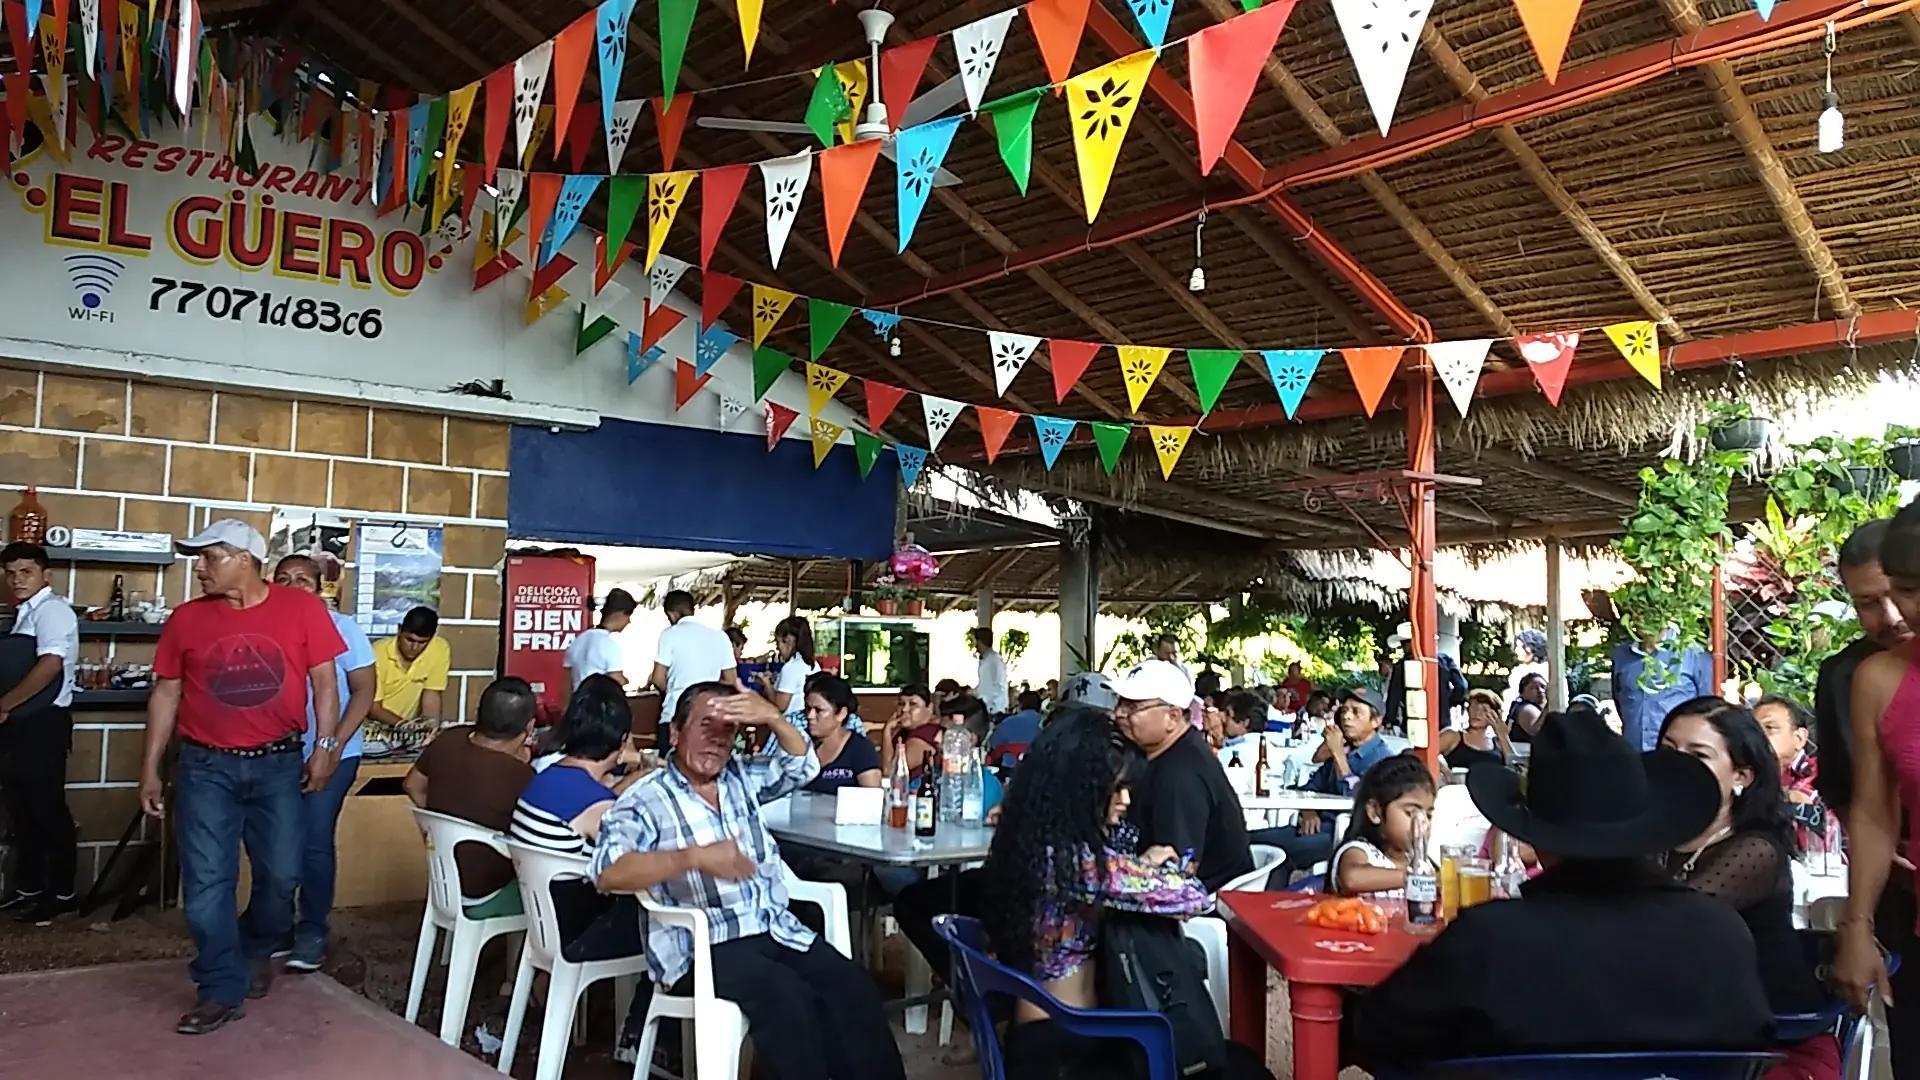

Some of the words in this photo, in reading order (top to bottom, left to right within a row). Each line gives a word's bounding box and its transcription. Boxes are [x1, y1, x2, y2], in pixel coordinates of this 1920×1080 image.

[48, 172, 152, 254] EL
[168, 188, 426, 294] GÜERO
[68, 305, 115, 324] WI-FI
[148, 276, 383, 339] 77071d83c6
[514, 596, 582, 604] REFRESCANTE
[518, 586, 578, 595] DELICIOSA
[514, 610, 582, 630] BIEN
[513, 632, 576, 650] FRÍA
[1794, 802, 1823, 826] 18
